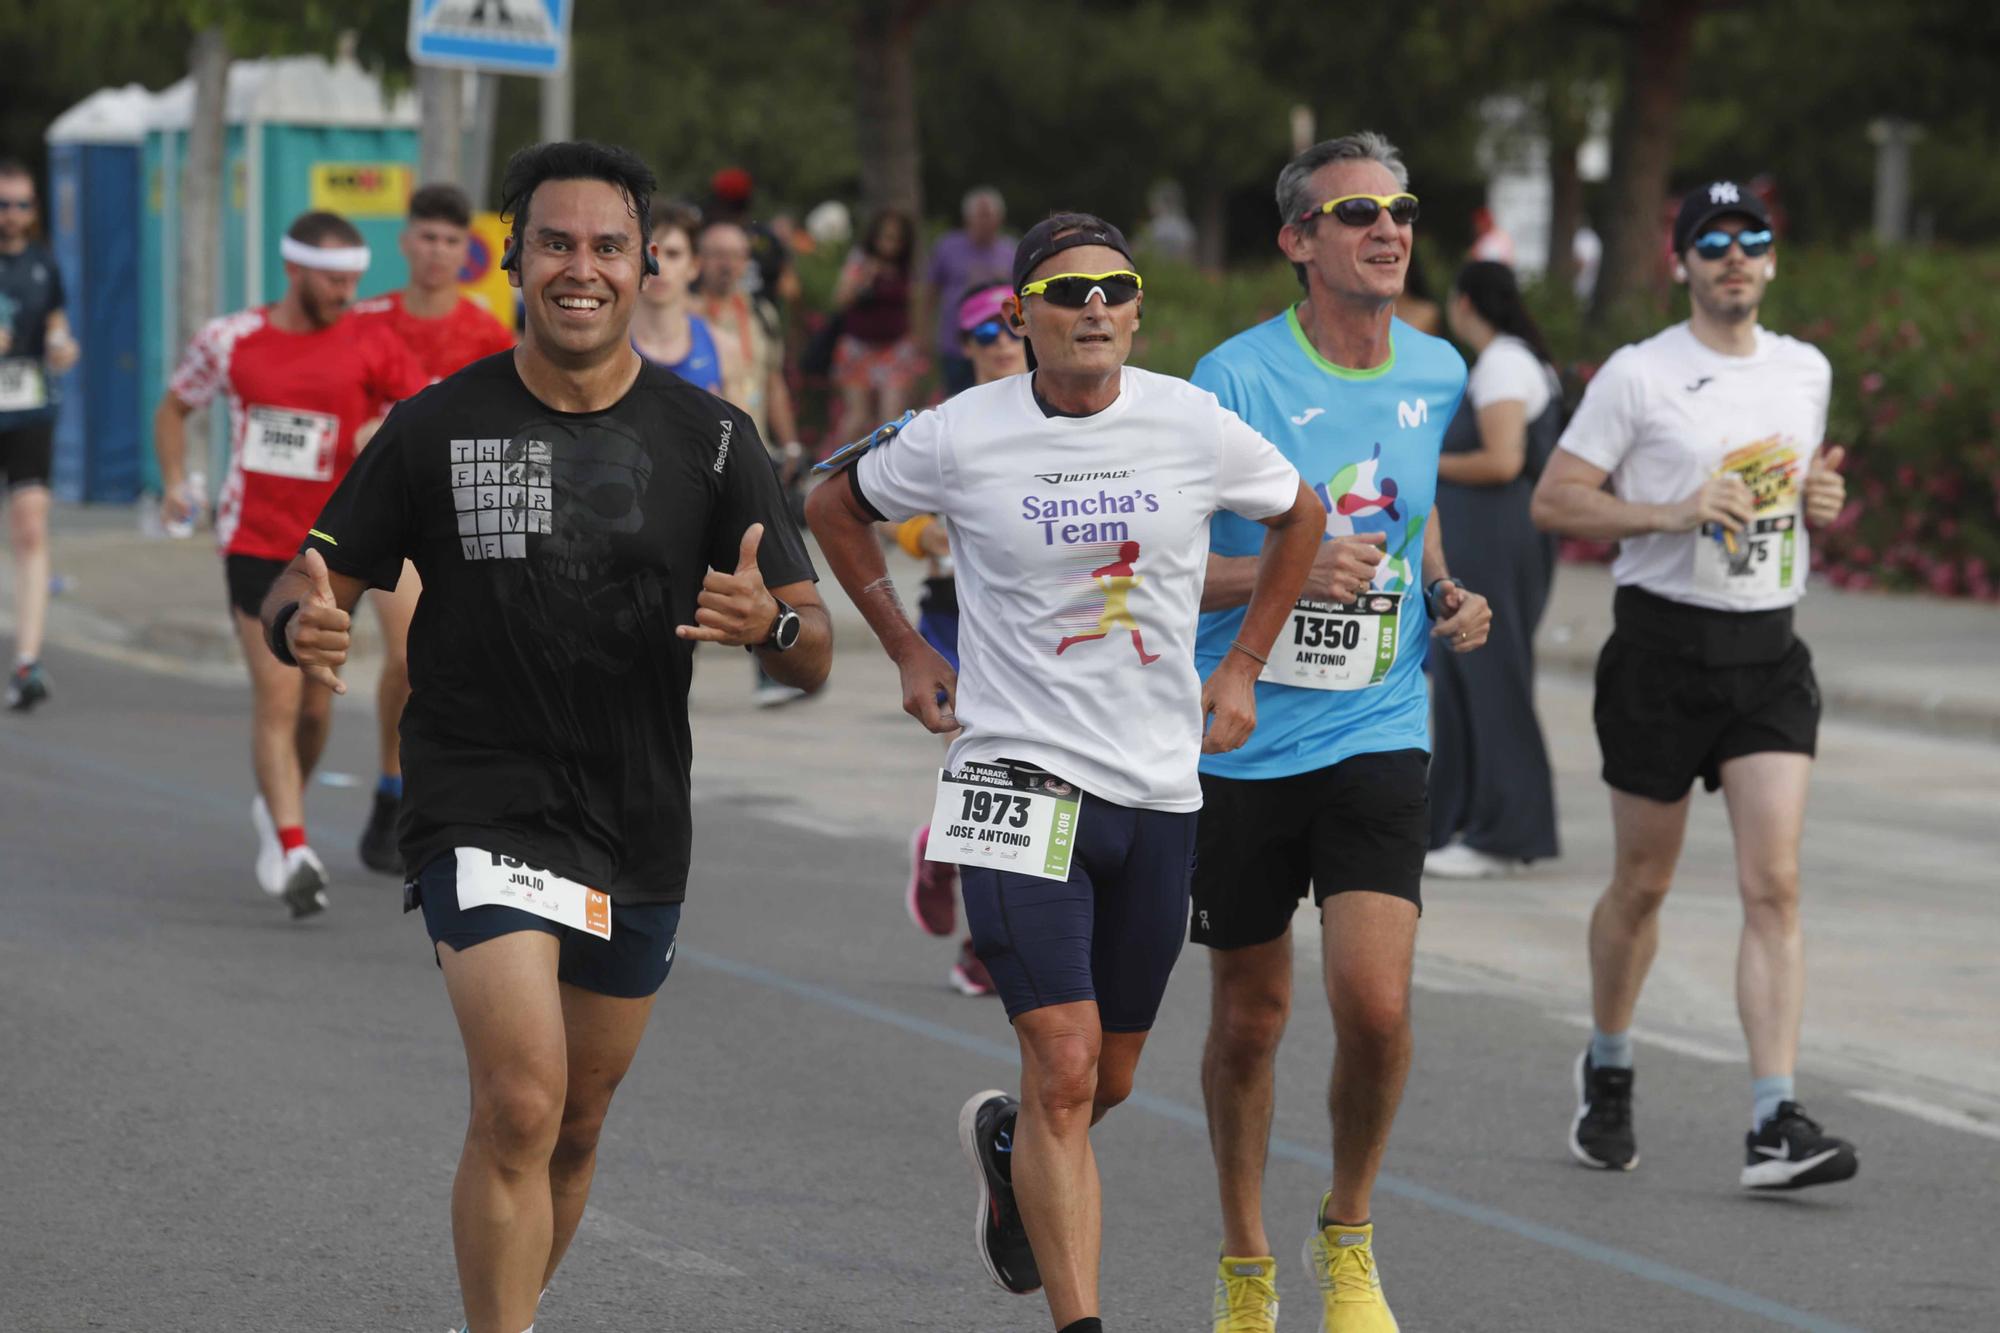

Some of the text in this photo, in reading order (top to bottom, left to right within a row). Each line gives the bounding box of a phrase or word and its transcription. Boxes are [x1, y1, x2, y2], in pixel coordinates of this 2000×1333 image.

[713, 431, 731, 474] Reebok
[1063, 470, 1131, 483] OUTPACE
[1022, 489, 1159, 521] Sancha's
[1036, 520, 1129, 546] Team
[1294, 615, 1360, 650] 1350
[1382, 627, 1393, 648] BOX
[1295, 651, 1346, 667] ANTONIO
[970, 774, 980, 782] DE
[981, 775, 1013, 787] PATERNA
[961, 789, 1032, 828] 1973
[945, 824, 1031, 848] JOSE ANTONIO
[1055, 812, 1071, 846] BOX 3
[508, 872, 544, 892] JULIO
[591, 893, 603, 904] 2
